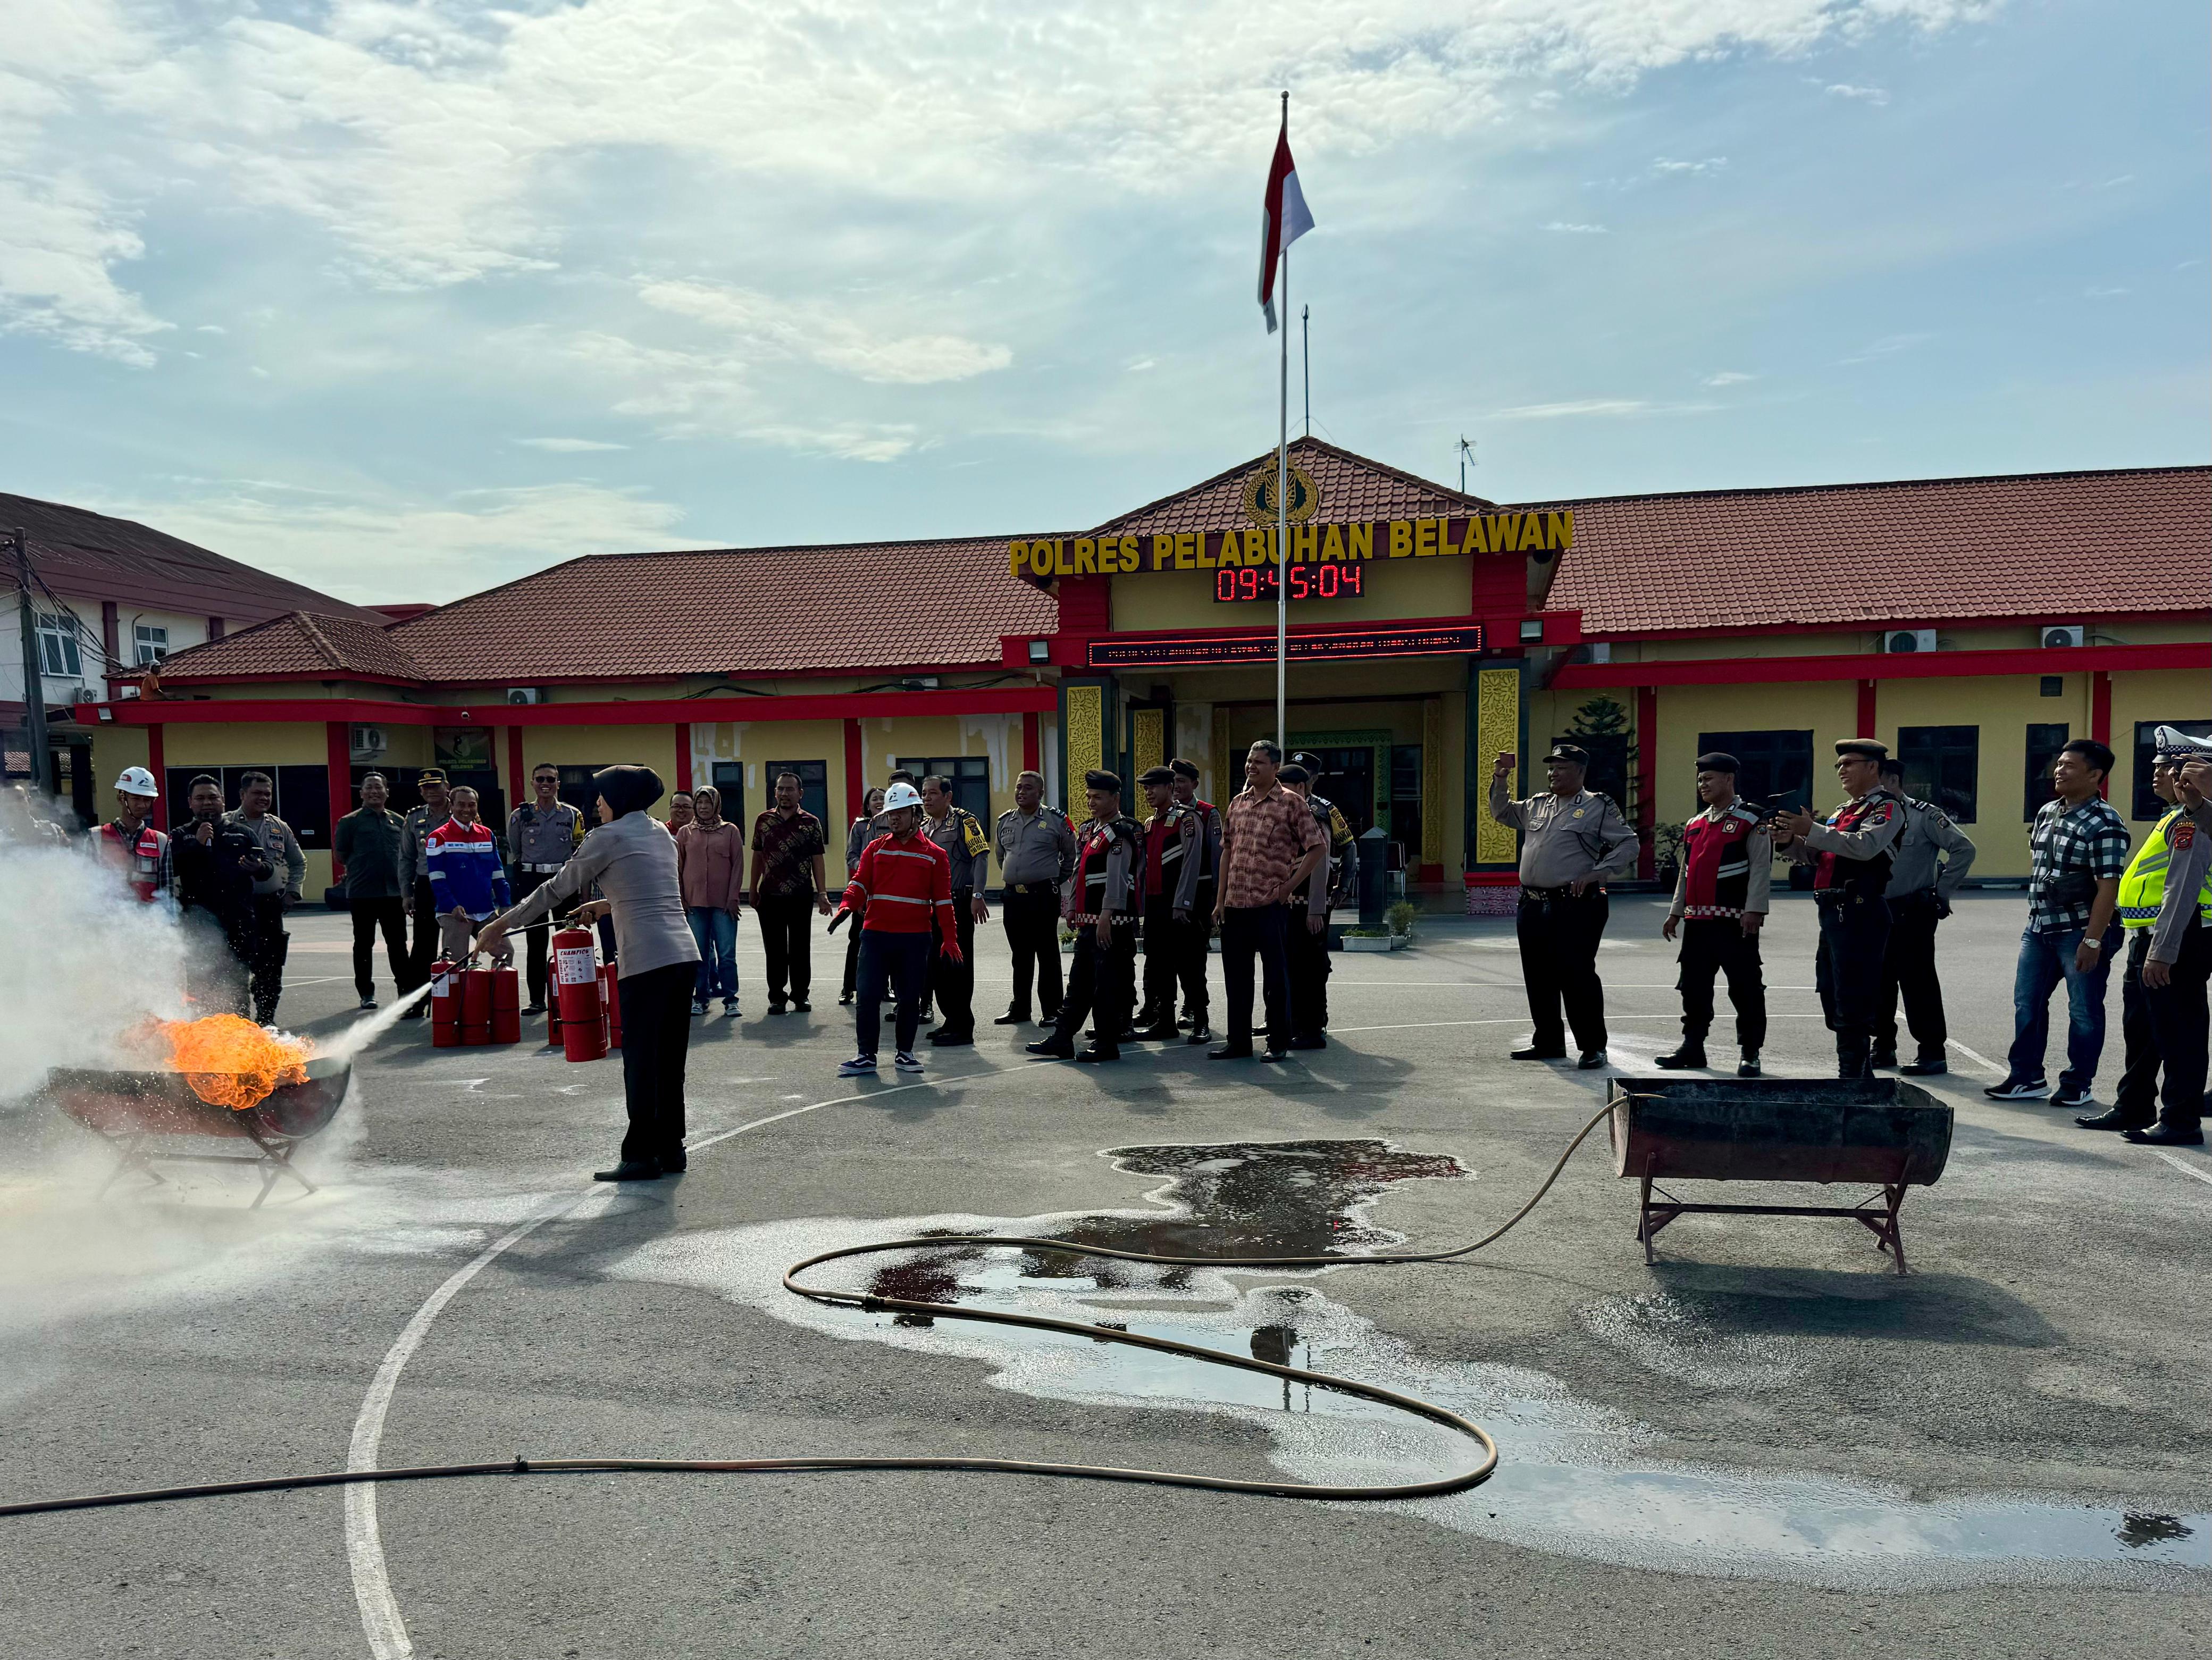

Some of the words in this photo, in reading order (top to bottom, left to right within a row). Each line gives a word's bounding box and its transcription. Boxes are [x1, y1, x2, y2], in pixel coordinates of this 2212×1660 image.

[1011, 536, 1140, 576] POLRES
[1153, 522, 1373, 571] PELABUHAN
[1389, 510, 1573, 558] BELAWAN
